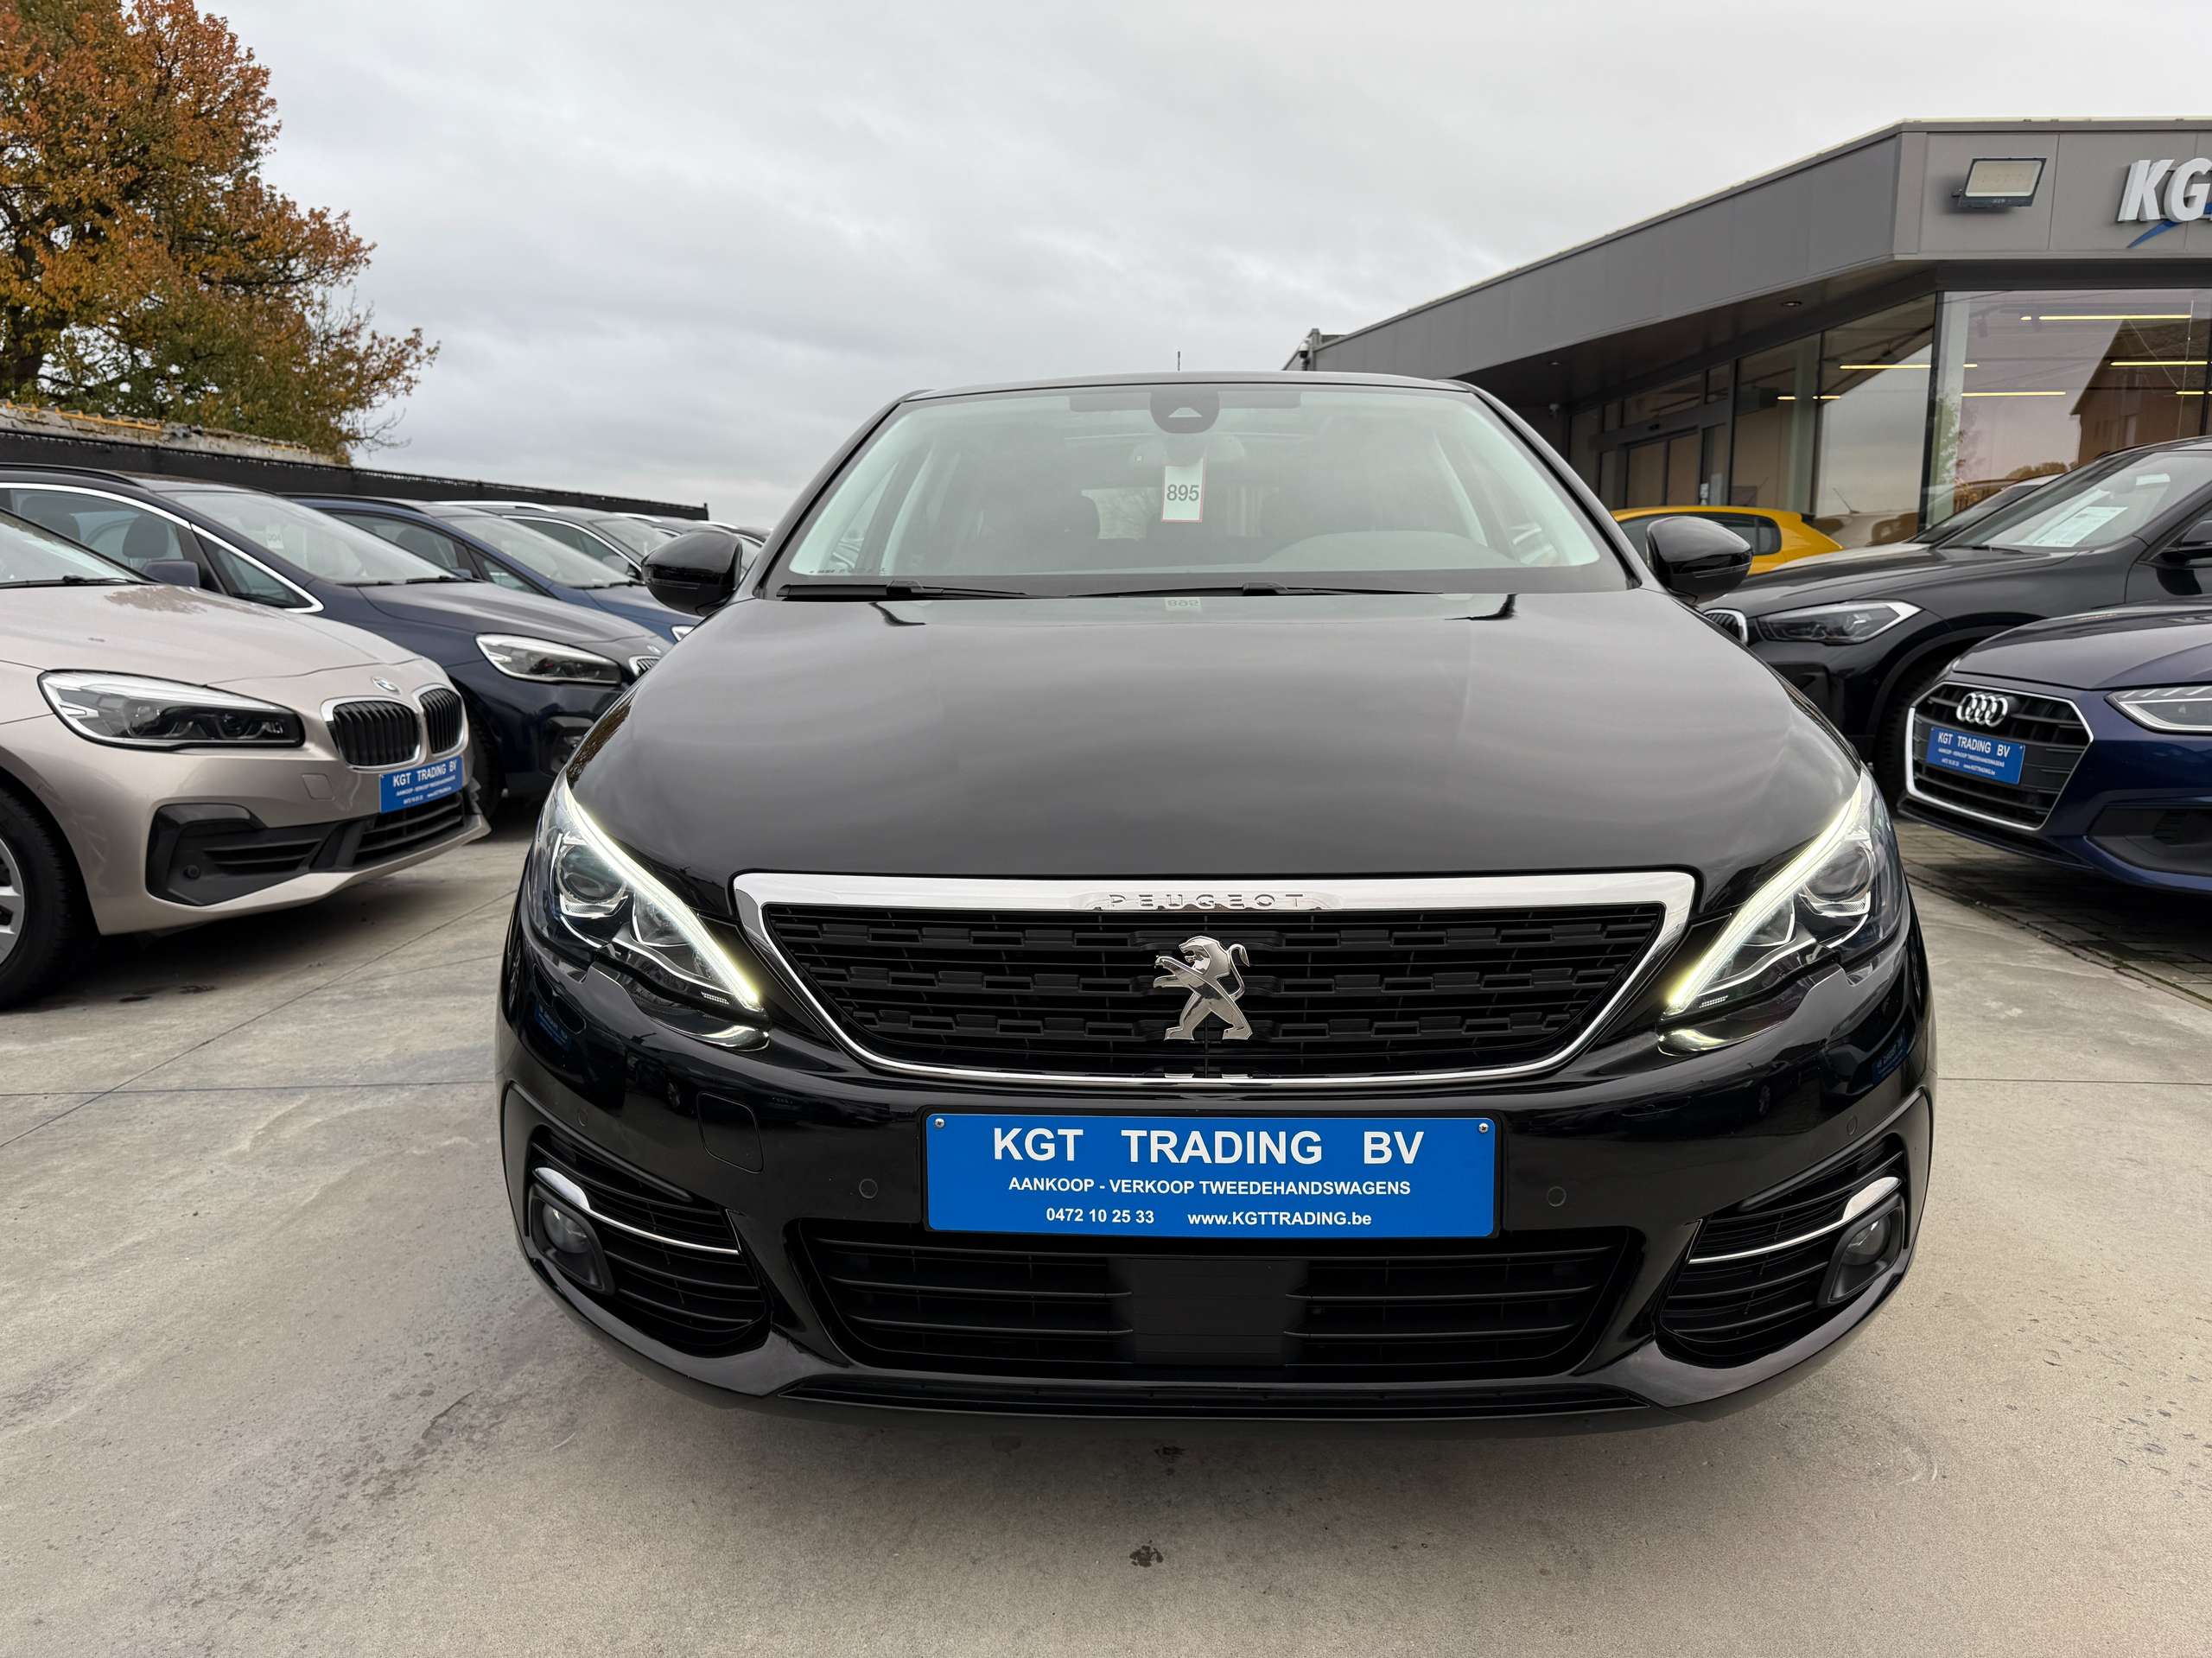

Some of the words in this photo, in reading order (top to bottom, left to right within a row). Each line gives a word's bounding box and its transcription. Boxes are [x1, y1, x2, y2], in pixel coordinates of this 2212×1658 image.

[1166, 484, 1199, 501] 895
[1937, 732, 1953, 746] KGT
[1957, 735, 1992, 754] TRADING
[1997, 744, 2011, 758] BV
[392, 772, 411, 787] KGT
[416, 764, 446, 782] TRADING
[449, 759, 457, 772] BV
[1109, 893, 1304, 907] PEUGEOT
[994, 1128, 1084, 1161] KGT
[1121, 1129, 1323, 1165] TRADING
[1363, 1131, 1425, 1165] BV
[1008, 1177, 1095, 1192] AANKOOP
[1109, 1178, 1195, 1195] VERKOOP
[1198, 1180, 1411, 1196] TWEEDEHANDSWAGENS
[1046, 1207, 1084, 1222] 0472
[1089, 1209, 1107, 1223] 10
[1112, 1209, 1131, 1223] 25
[1135, 1210, 1154, 1224] 33
[1187, 1211, 1372, 1226] www.KGTTRADING.be
